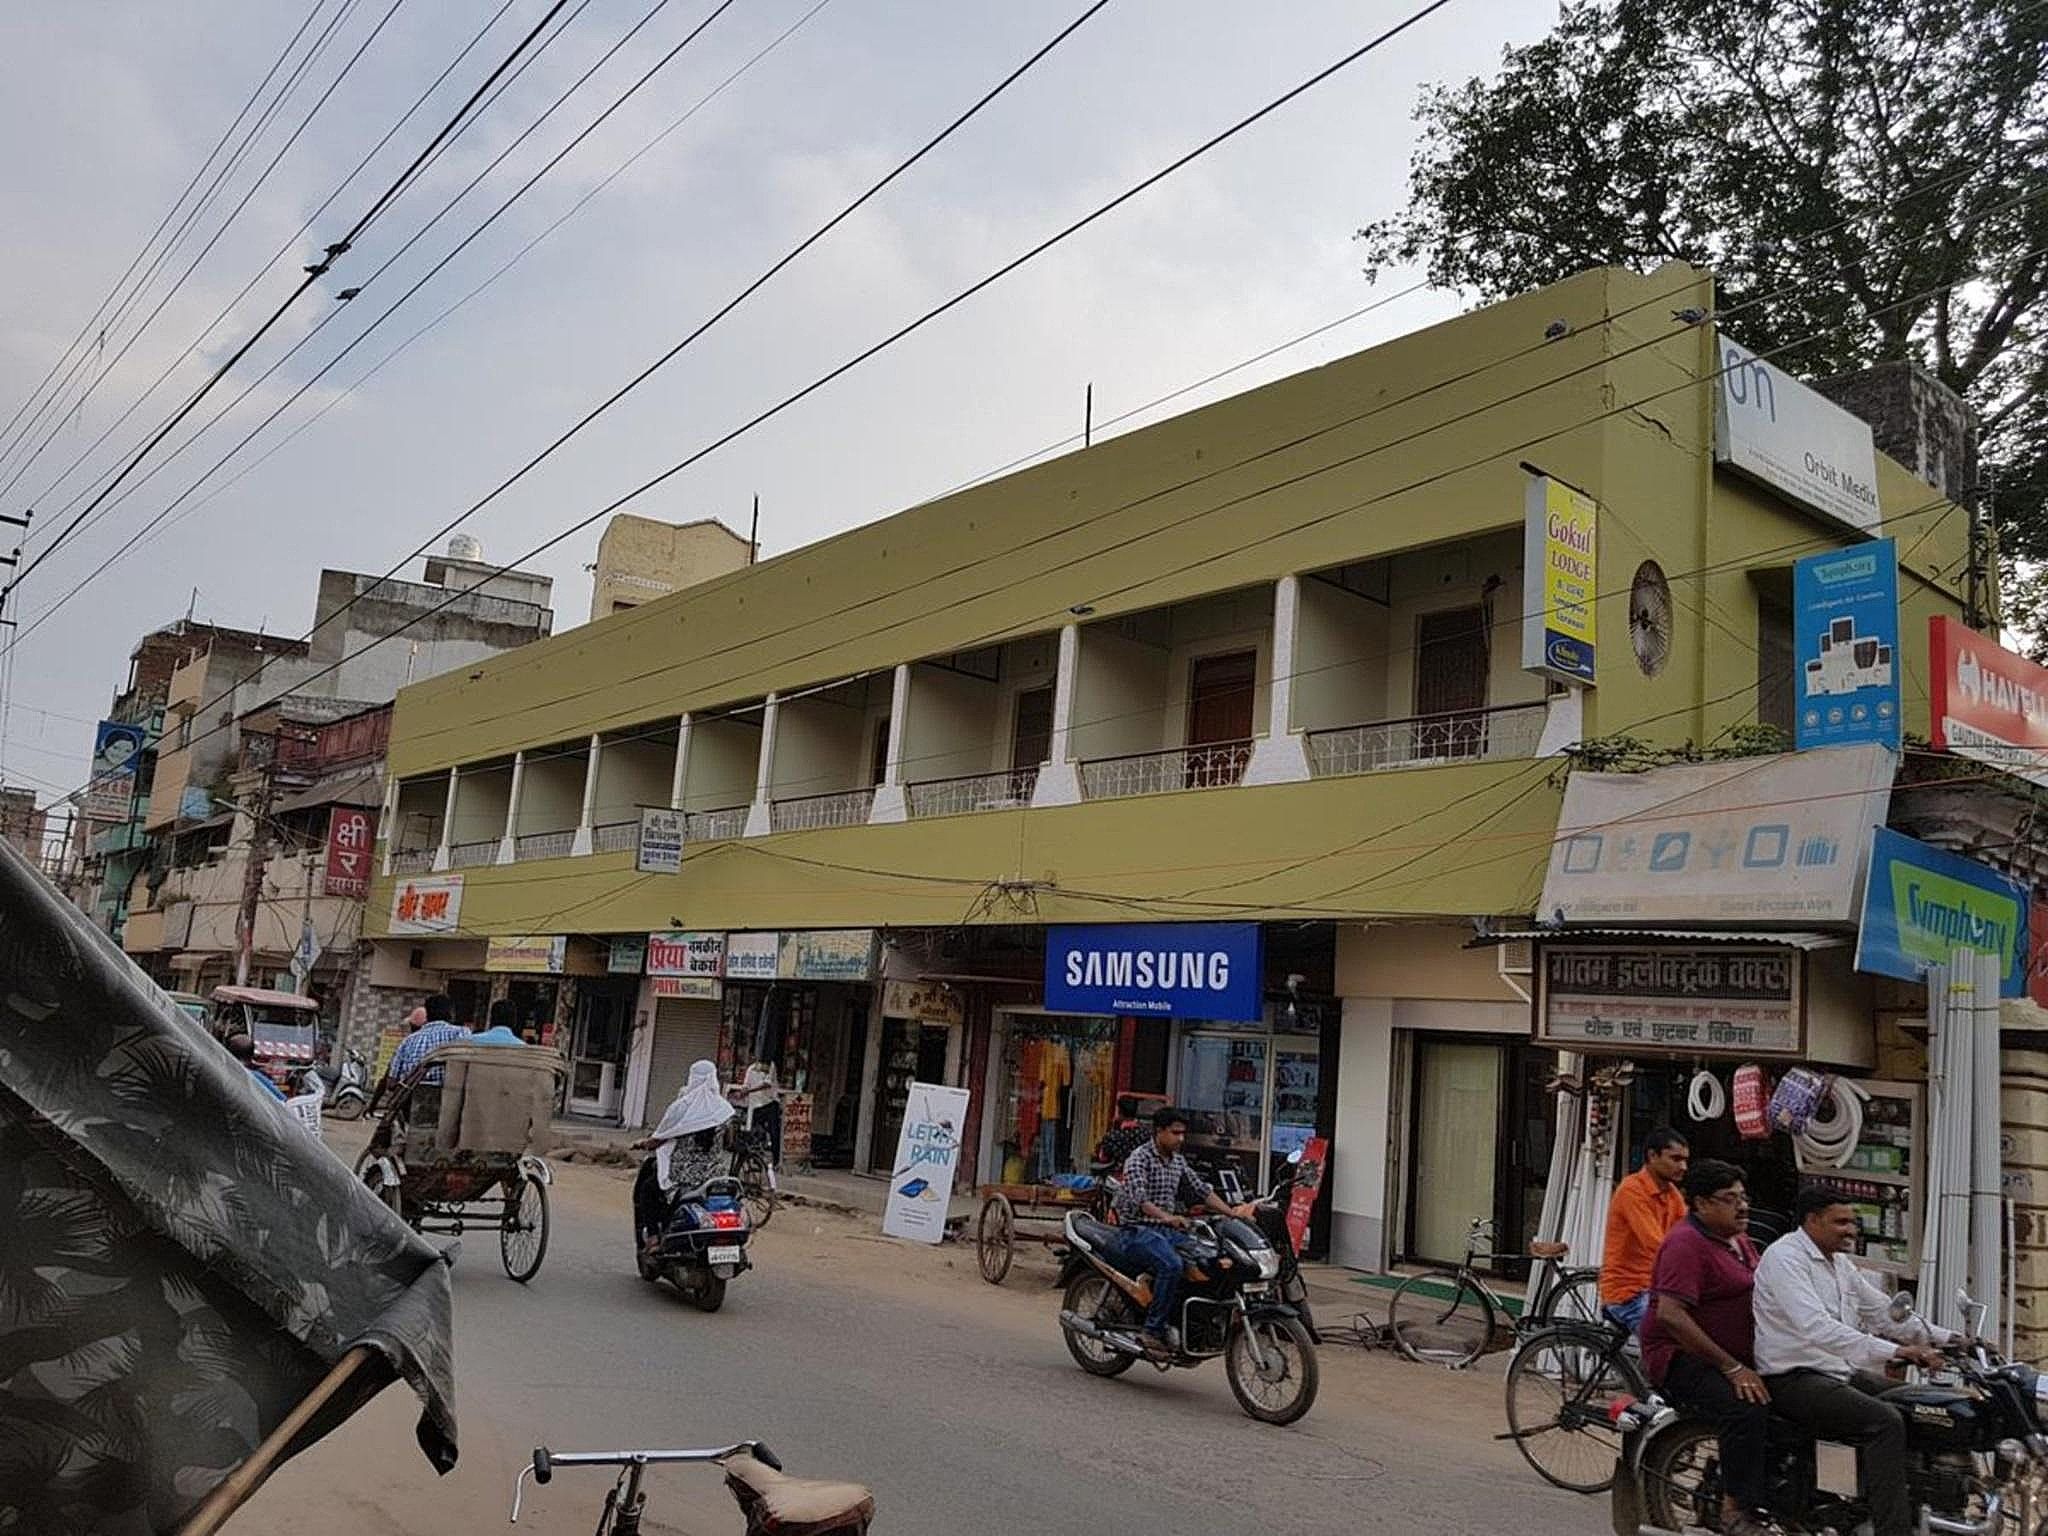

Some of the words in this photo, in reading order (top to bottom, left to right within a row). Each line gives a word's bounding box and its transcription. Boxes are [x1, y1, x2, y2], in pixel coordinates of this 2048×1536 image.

[1805, 452, 1837, 487] Orbit
[1549, 513, 1592, 553] Gokul
[1552, 549, 1591, 581] LODGE
[1909, 882, 2006, 954] Symphony
[649, 938, 687, 969] प्रिया
[1066, 950, 1229, 990] SAMSUNG
[1112, 999, 1148, 1010] Attraction
[1149, 1000, 1172, 1011] Mobile
[911, 1144, 950, 1166] RAIN
